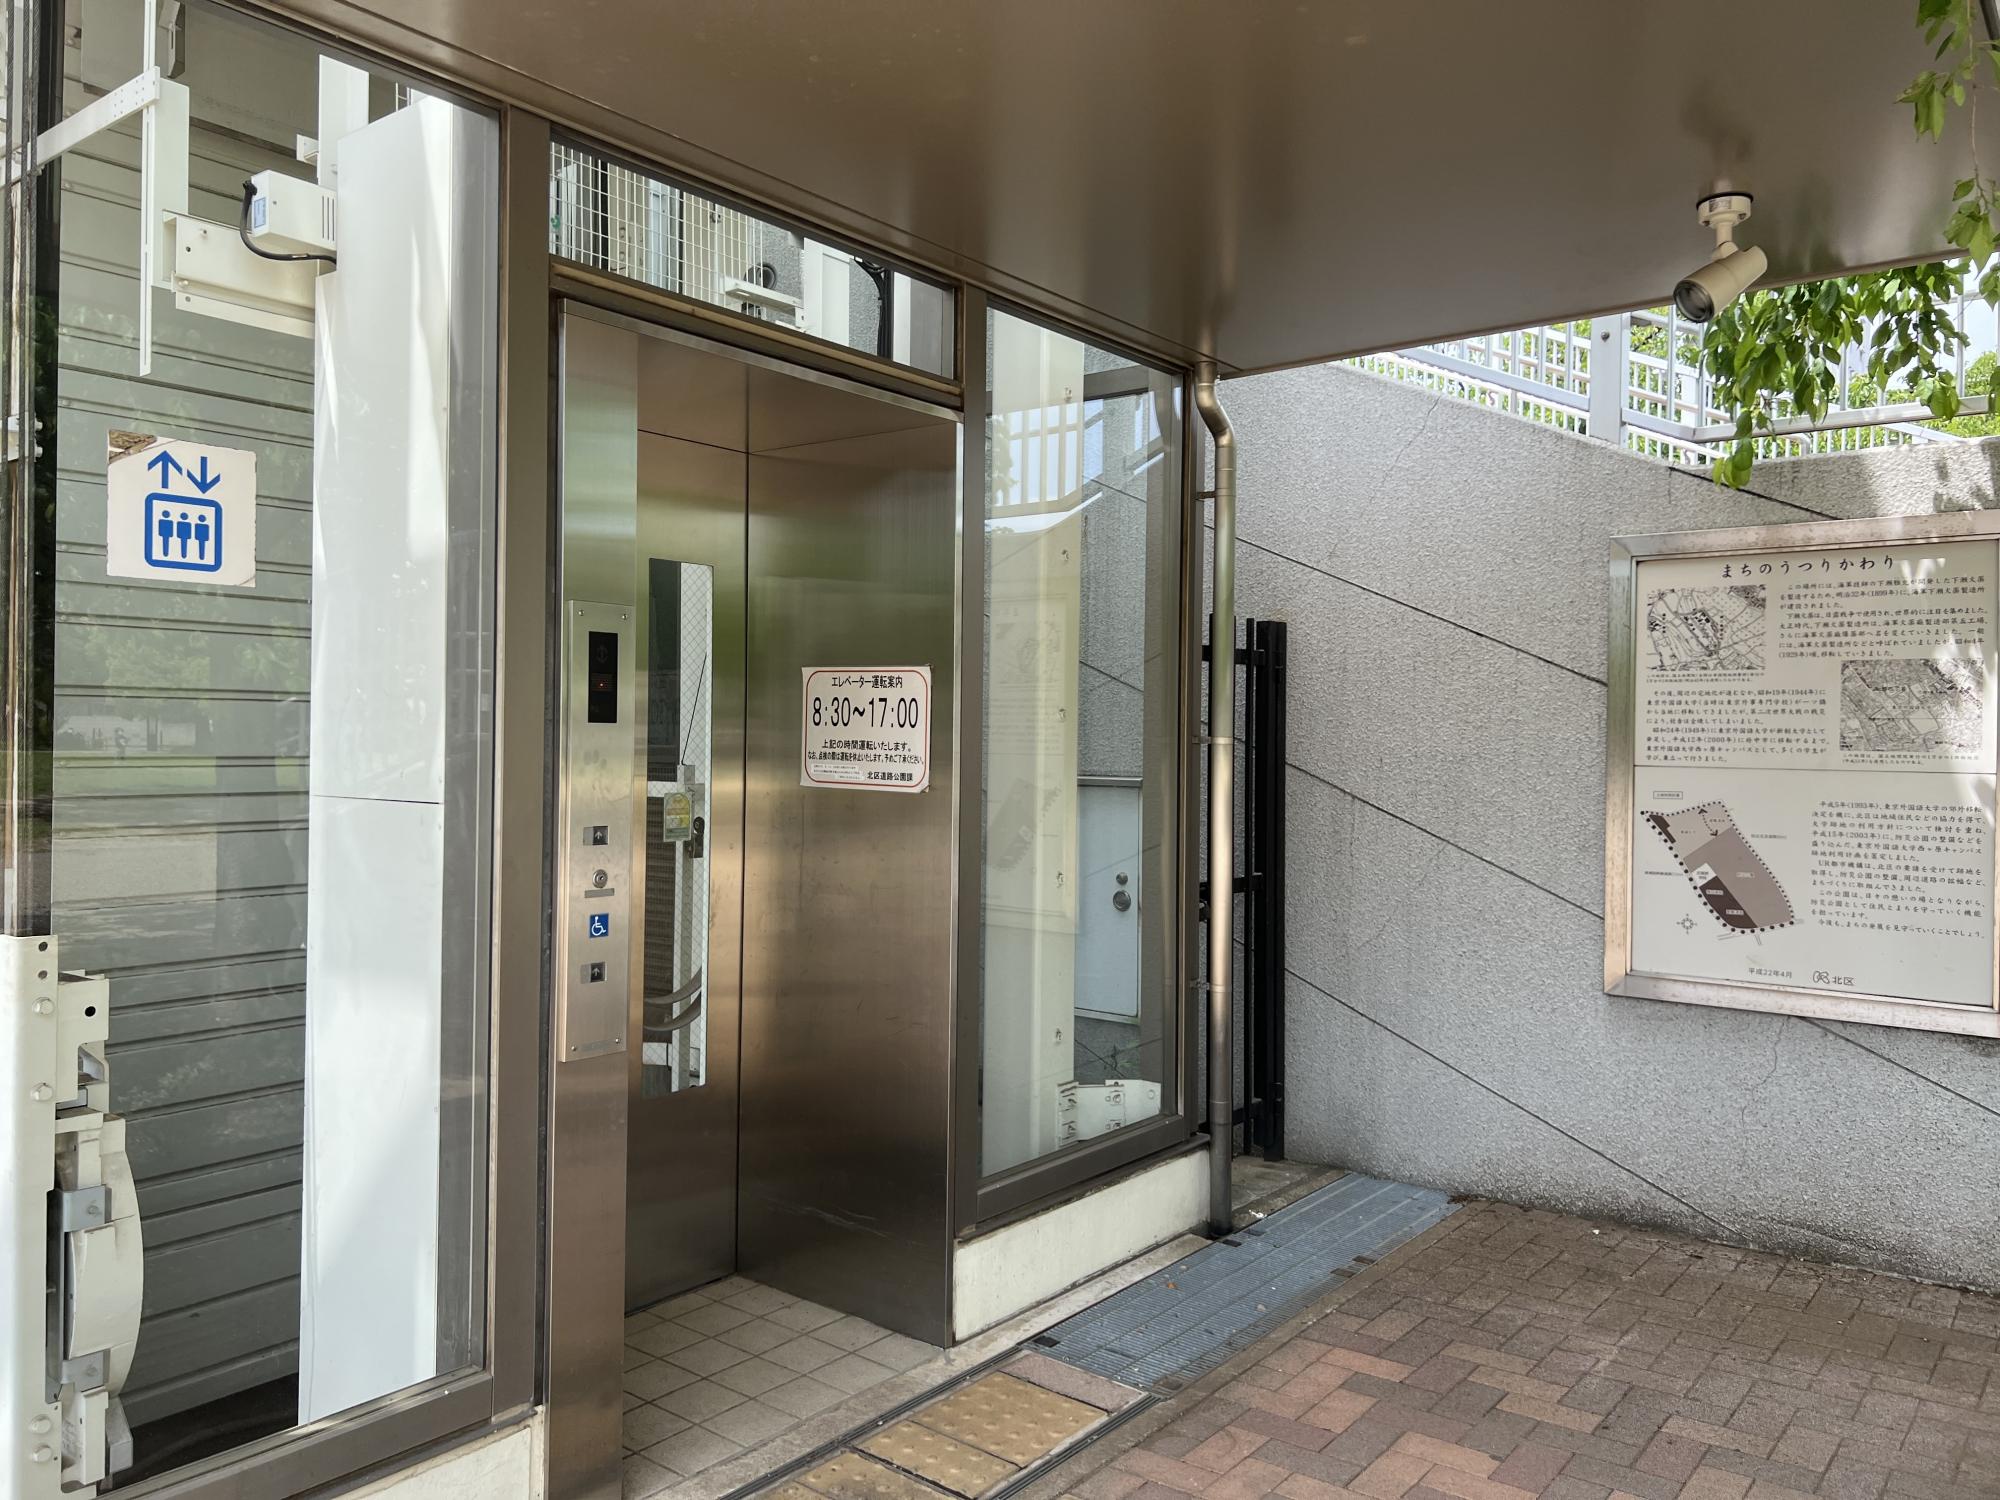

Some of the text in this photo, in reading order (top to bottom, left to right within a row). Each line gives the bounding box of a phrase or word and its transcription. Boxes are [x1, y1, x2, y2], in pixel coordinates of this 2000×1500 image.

[1721, 553, 1895, 579] まちのうつりかわり
[1780, 602, 1844, 610] が建設されました。
[831, 675, 903, 688] エレベーター運転案内
[822, 739, 912, 753] 上記の時間運転いたします。
[867, 770, 913, 782] 北区道路公園課
[1748, 967, 1793, 979] 平成22年4月
[1832, 975, 1855, 986] 北区
